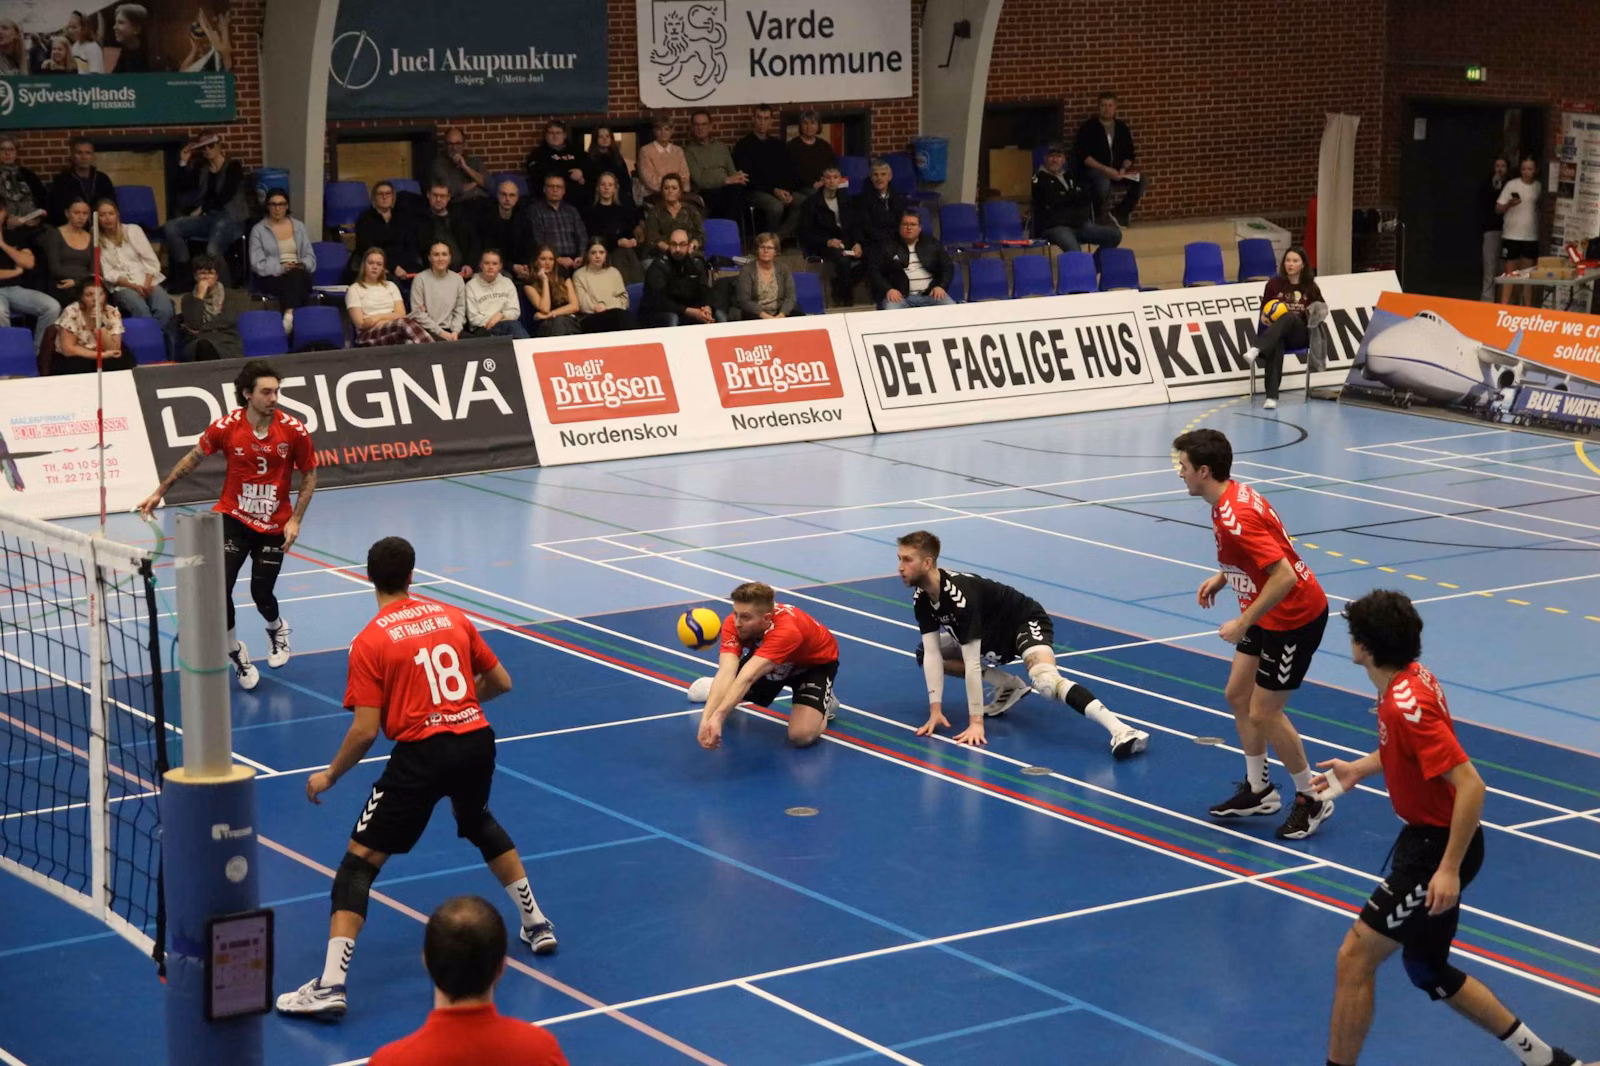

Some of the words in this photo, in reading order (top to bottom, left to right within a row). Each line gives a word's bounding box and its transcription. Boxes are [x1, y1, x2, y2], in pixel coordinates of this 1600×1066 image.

[746, 9, 834, 40] Varde
[389, 48, 435, 75] Juel
[440, 46, 577, 78] Akupunktur
[750, 48, 902, 77] Kommune
[454, 75, 485, 85] Esbjerg
[19, 86, 136, 107] Sydvestjyllands
[92, 101, 136, 109] EFTERSKOLE
[1496, 310, 1559, 333] Together
[1562, 322, 1583, 336] we
[874, 340, 937, 398] DET
[944, 329, 1075, 391] FAGLIGE
[1080, 321, 1141, 380] HUS
[721, 357, 829, 392] Brugsen
[550, 373, 665, 408] Brugsen
[1526, 390, 1563, 413] BLUE
[731, 407, 842, 430] Nordenskov
[559, 423, 677, 448] Nordenskov
[62, 461, 74, 471] 40
[78, 460, 89, 469] 10
[105, 457, 118, 467] 30
[343, 439, 433, 465] HVERDAG
[65, 473, 77, 483] 22
[80, 472, 91, 481] 72
[108, 468, 120, 478] 77
[256, 456, 268, 475] 3
[242, 483, 278, 502] BLUE
[376, 603, 444, 628] DUMBUYAH
[389, 626, 406, 641] DET
[404, 618, 437, 636] FAGLIGE
[434, 615, 453, 629] HUS
[414, 643, 468, 705] 18
[442, 706, 478, 722] TOYOTA
